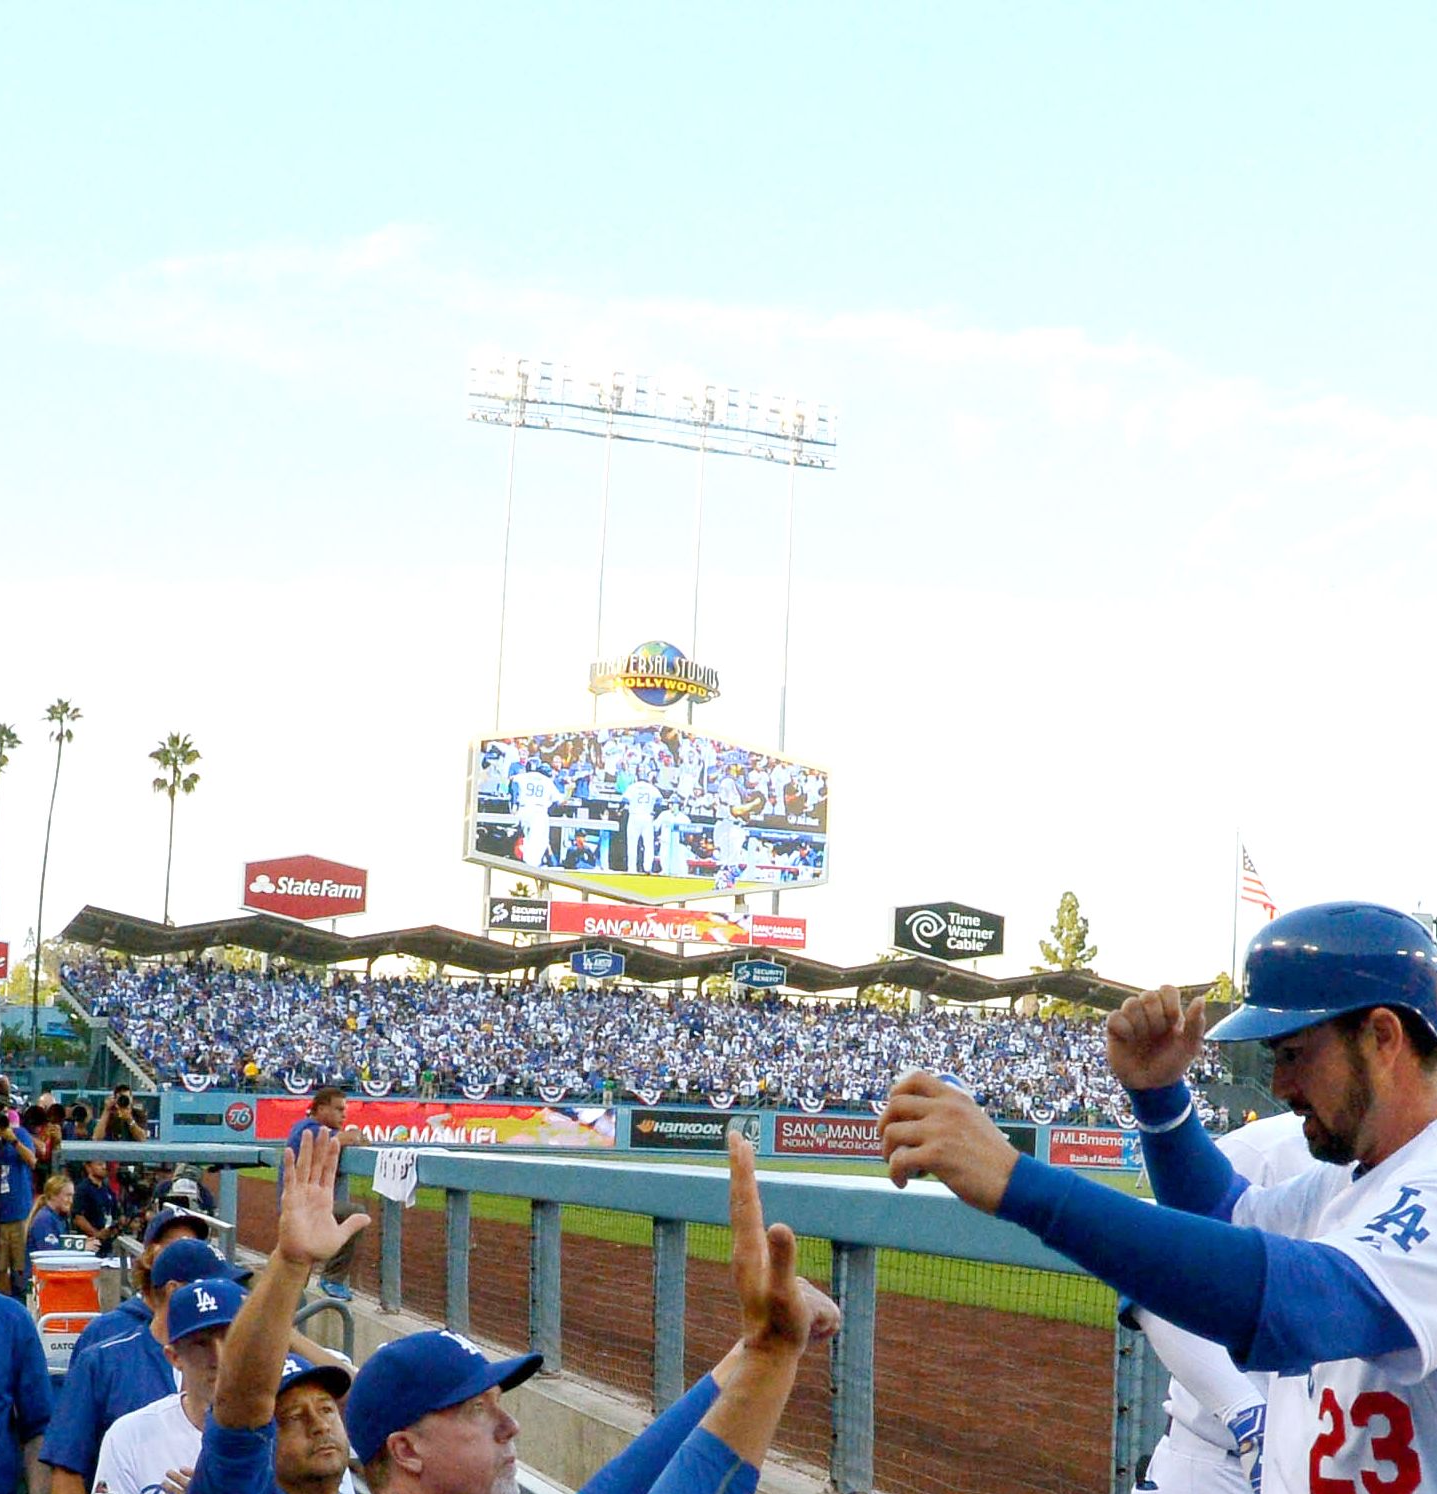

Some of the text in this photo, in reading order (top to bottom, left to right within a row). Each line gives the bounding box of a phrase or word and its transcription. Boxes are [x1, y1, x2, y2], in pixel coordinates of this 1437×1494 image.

[674, 656, 719, 689] STUDIOS
[525, 783, 545, 798] 98
[511, 905, 548, 916] SECURITY
[947, 911, 981, 926] Time
[584, 917, 702, 941] SAN MANUEL
[946, 924, 995, 940] Warner
[946, 937, 984, 952] Cable
[752, 967, 784, 978] SECURITY
[229, 1108, 250, 1125] 76
[782, 1122, 881, 1141] SAN MANUE
[782, 1138, 814, 1148] INDIAN
[1364, 1186, 1431, 1253] LA
[194, 1287, 219, 1313] LA
